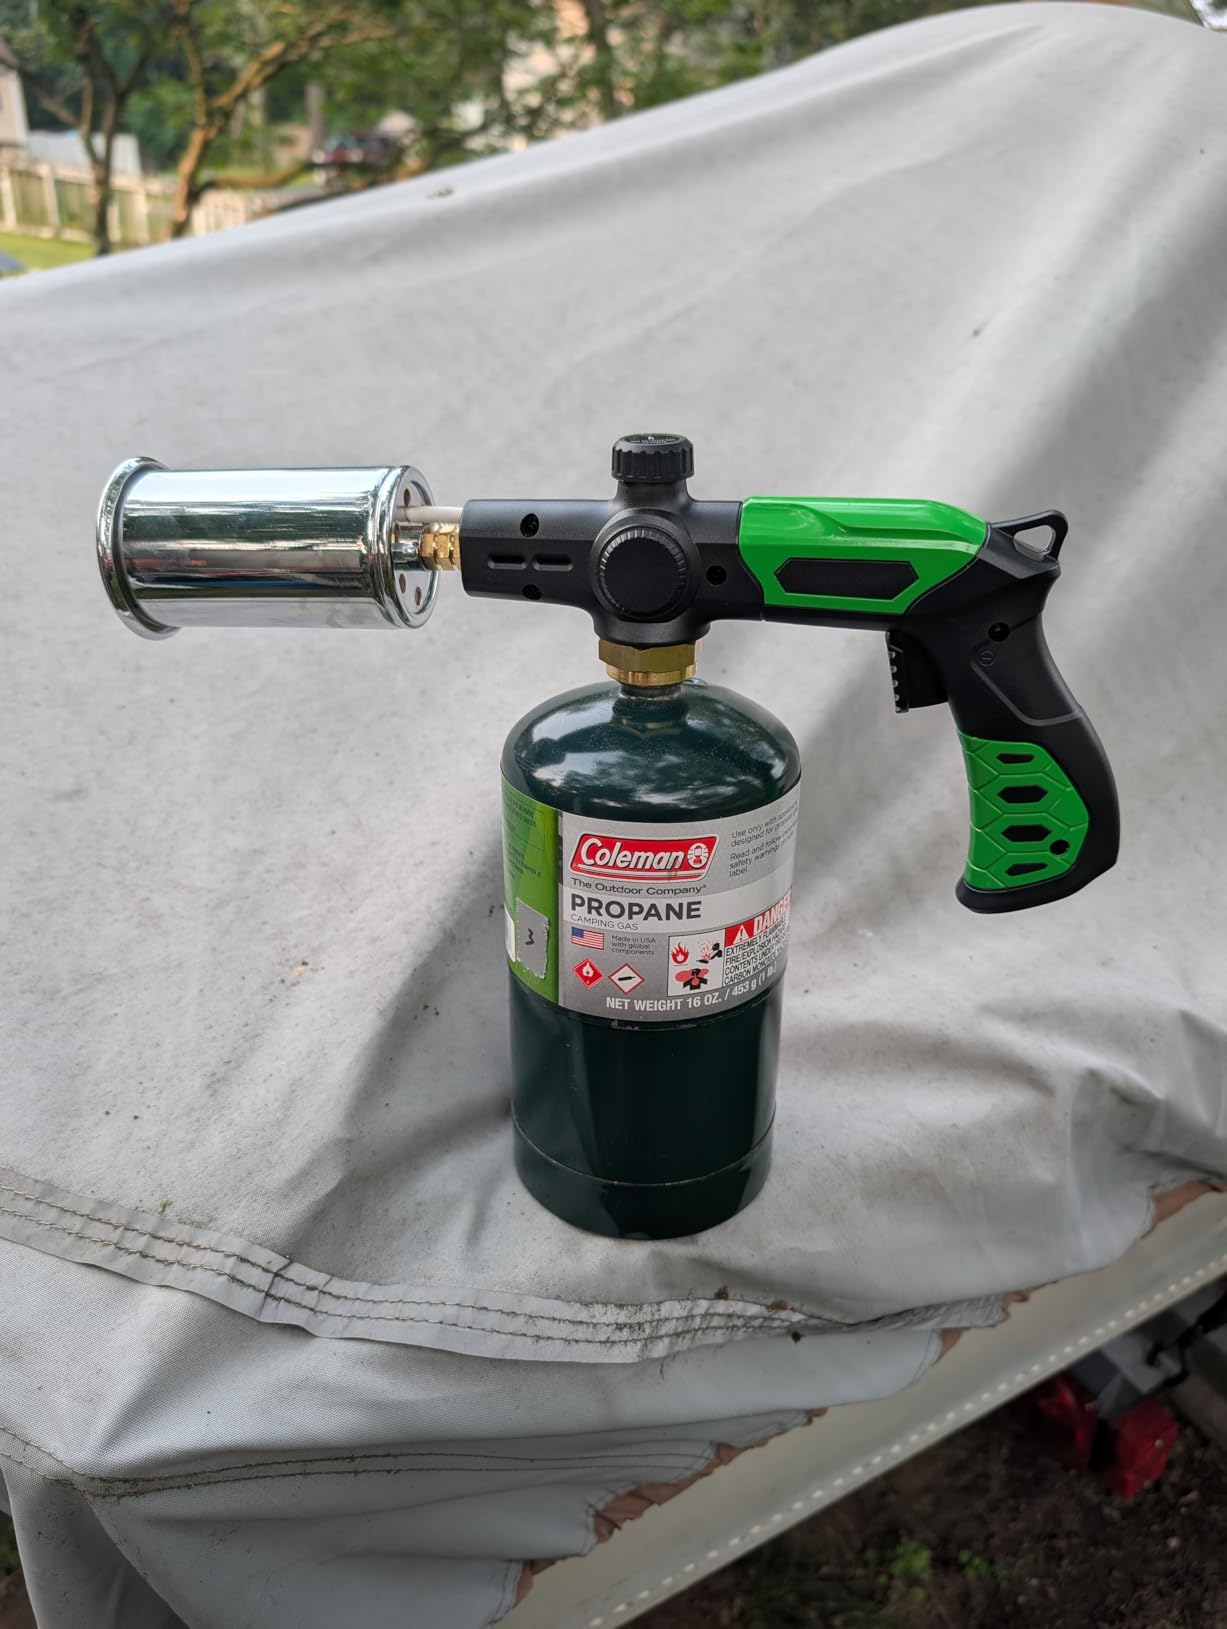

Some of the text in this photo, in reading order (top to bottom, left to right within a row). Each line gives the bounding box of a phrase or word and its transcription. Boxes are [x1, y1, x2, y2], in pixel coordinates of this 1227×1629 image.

[730, 830, 764, 848] designed
[731, 829, 747, 839] Use
[748, 823, 763, 834] only
[581, 838, 684, 870] Coleman
[730, 848, 750, 861] Read
[751, 842, 764, 855] and
[729, 857, 753, 870] safety
[571, 877, 592, 889] The
[595, 882, 643, 895] Outdoor
[571, 893, 702, 921] PROPANE
[570, 913, 639, 931] CAMPING GAS
[611, 935, 631, 943] Made
[628, 942, 651, 950] global
[726, 932, 762, 957] EXTREMELY
[611, 947, 655, 956] components
[725, 954, 758, 976] CONTENTS
[724, 967, 751, 986] CARBON
[606, 997, 631, 1010] NET
[634, 998, 684, 1012] WEIGHT
[686, 997, 701, 1009] 16
[704, 991, 722, 1007] OZ.
[731, 980, 750, 997] 453
[750, 978, 757, 991] g
